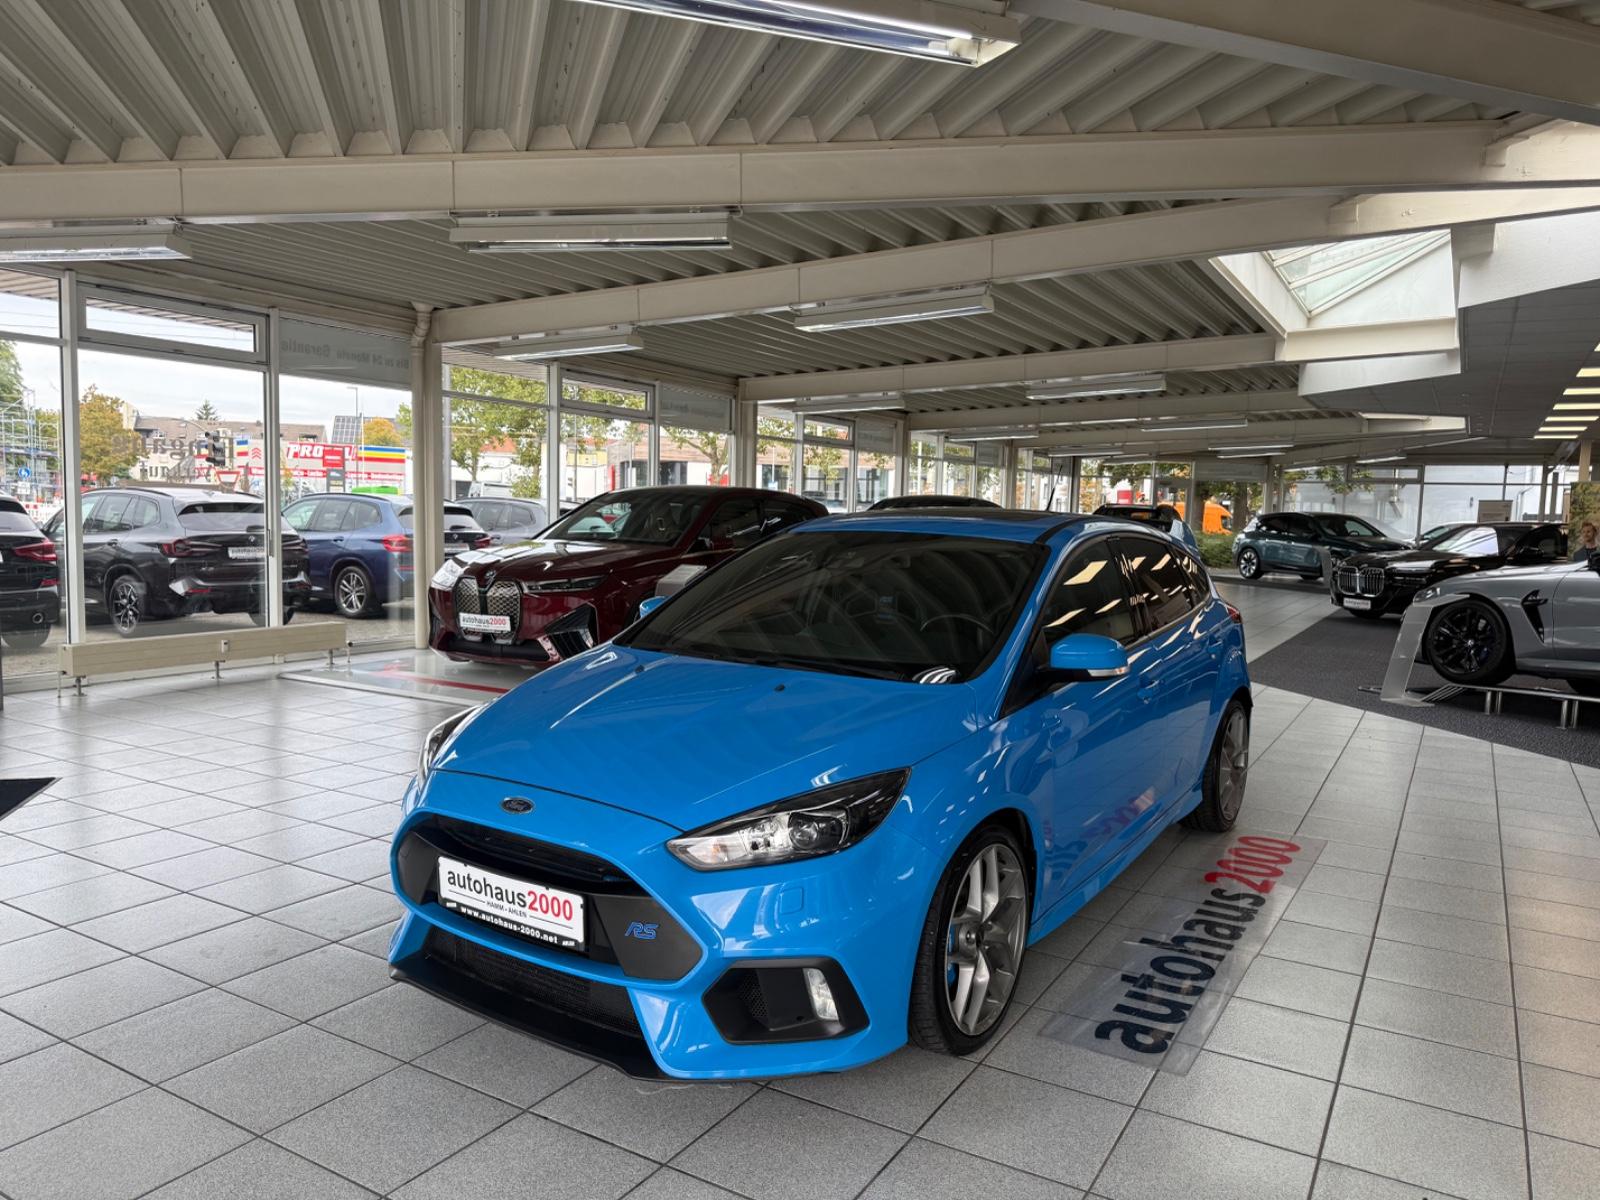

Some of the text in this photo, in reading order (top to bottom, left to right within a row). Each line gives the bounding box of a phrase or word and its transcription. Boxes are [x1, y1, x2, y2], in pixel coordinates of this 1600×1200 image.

[462, 616, 507, 626] autohaus2000
[447, 870, 574, 922] autohaus2000
[460, 906, 558, 944] www.autohaus-2000.net
[625, 922, 659, 940] RS
[1094, 836, 1301, 1054] autohaus2000
